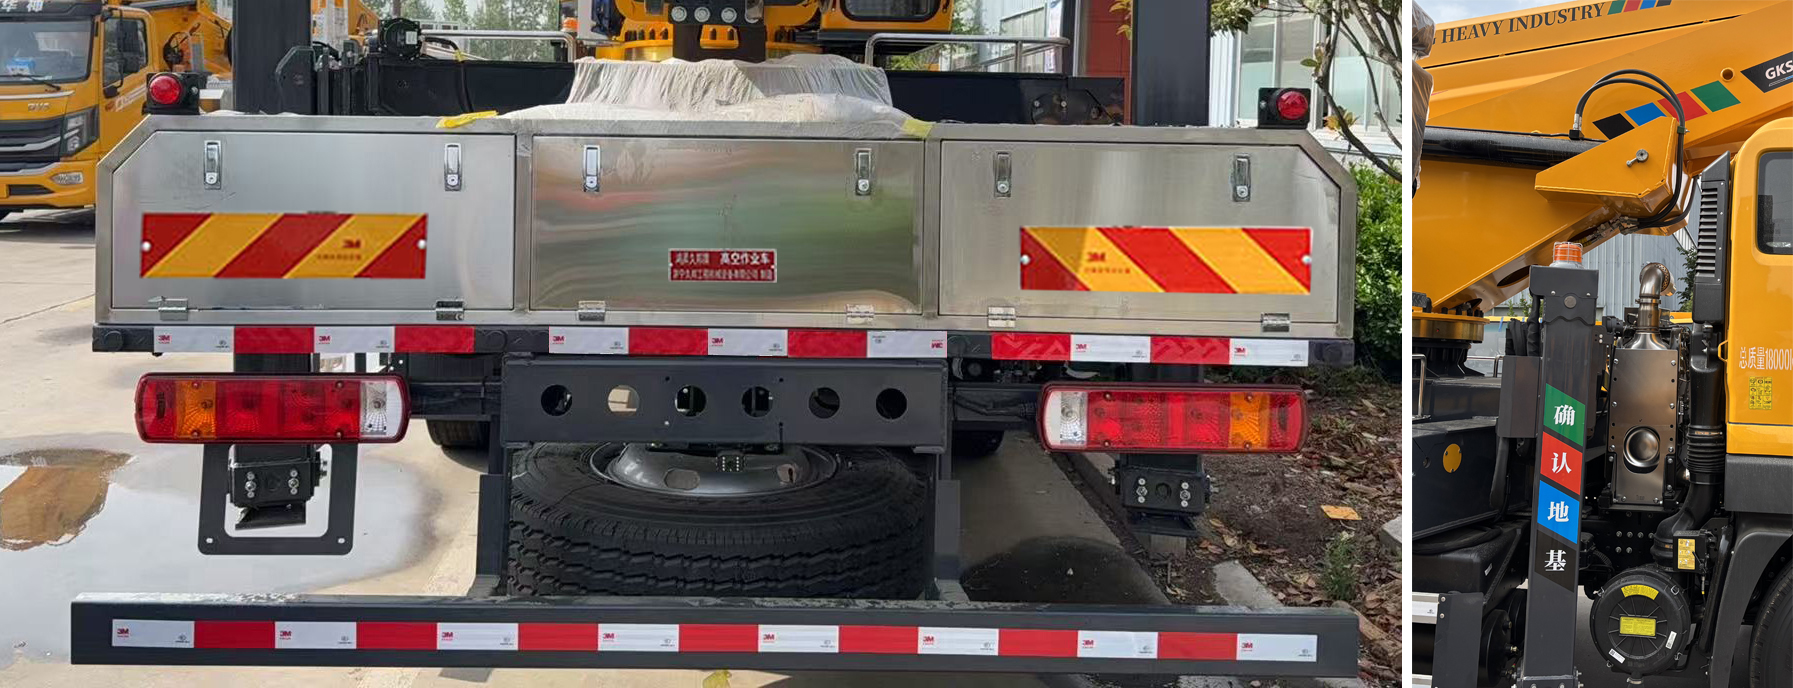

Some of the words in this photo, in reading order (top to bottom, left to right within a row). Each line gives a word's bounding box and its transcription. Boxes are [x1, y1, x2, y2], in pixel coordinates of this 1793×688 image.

[1441, 20, 1505, 44] HEAVY
[1508, 2, 1606, 33] INDUSTRY
[720, 252, 769, 265] 高空作业车
[1087, 252, 1106, 262] 3M
